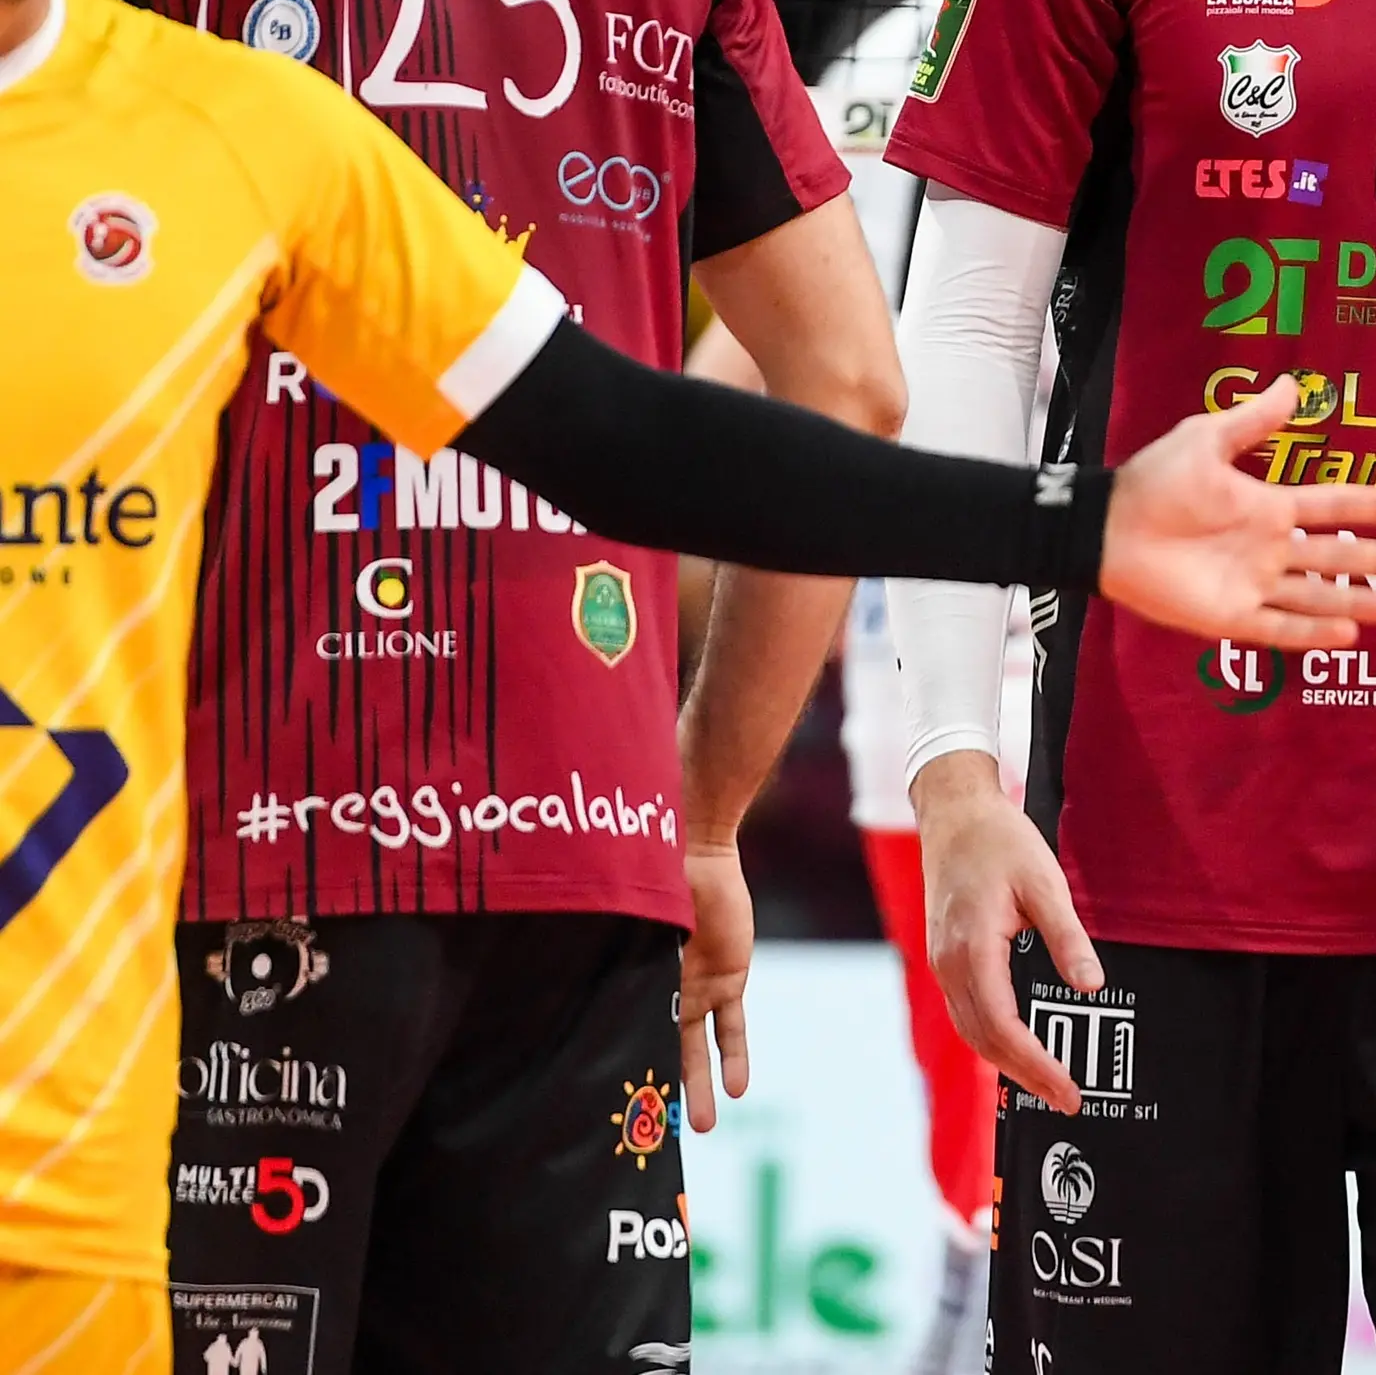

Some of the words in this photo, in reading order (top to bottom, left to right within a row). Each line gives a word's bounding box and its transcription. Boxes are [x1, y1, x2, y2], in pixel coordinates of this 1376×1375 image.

[1244, 6, 1260, 15] nel
[1261, 6, 1295, 16] mondo
[1227, 74, 1286, 110] C&C
[0, 466, 157, 548] nte
[316, 629, 458, 660] CILIONE
[1301, 689, 1370, 707] SERVIZI
[236, 770, 678, 849] #reggiocalabria
[177, 1040, 347, 1109] officina
[1134, 1102, 1159, 1121] srl
[177, 1163, 256, 1188] MULTI
[176, 1181, 256, 1205] SERVICE
